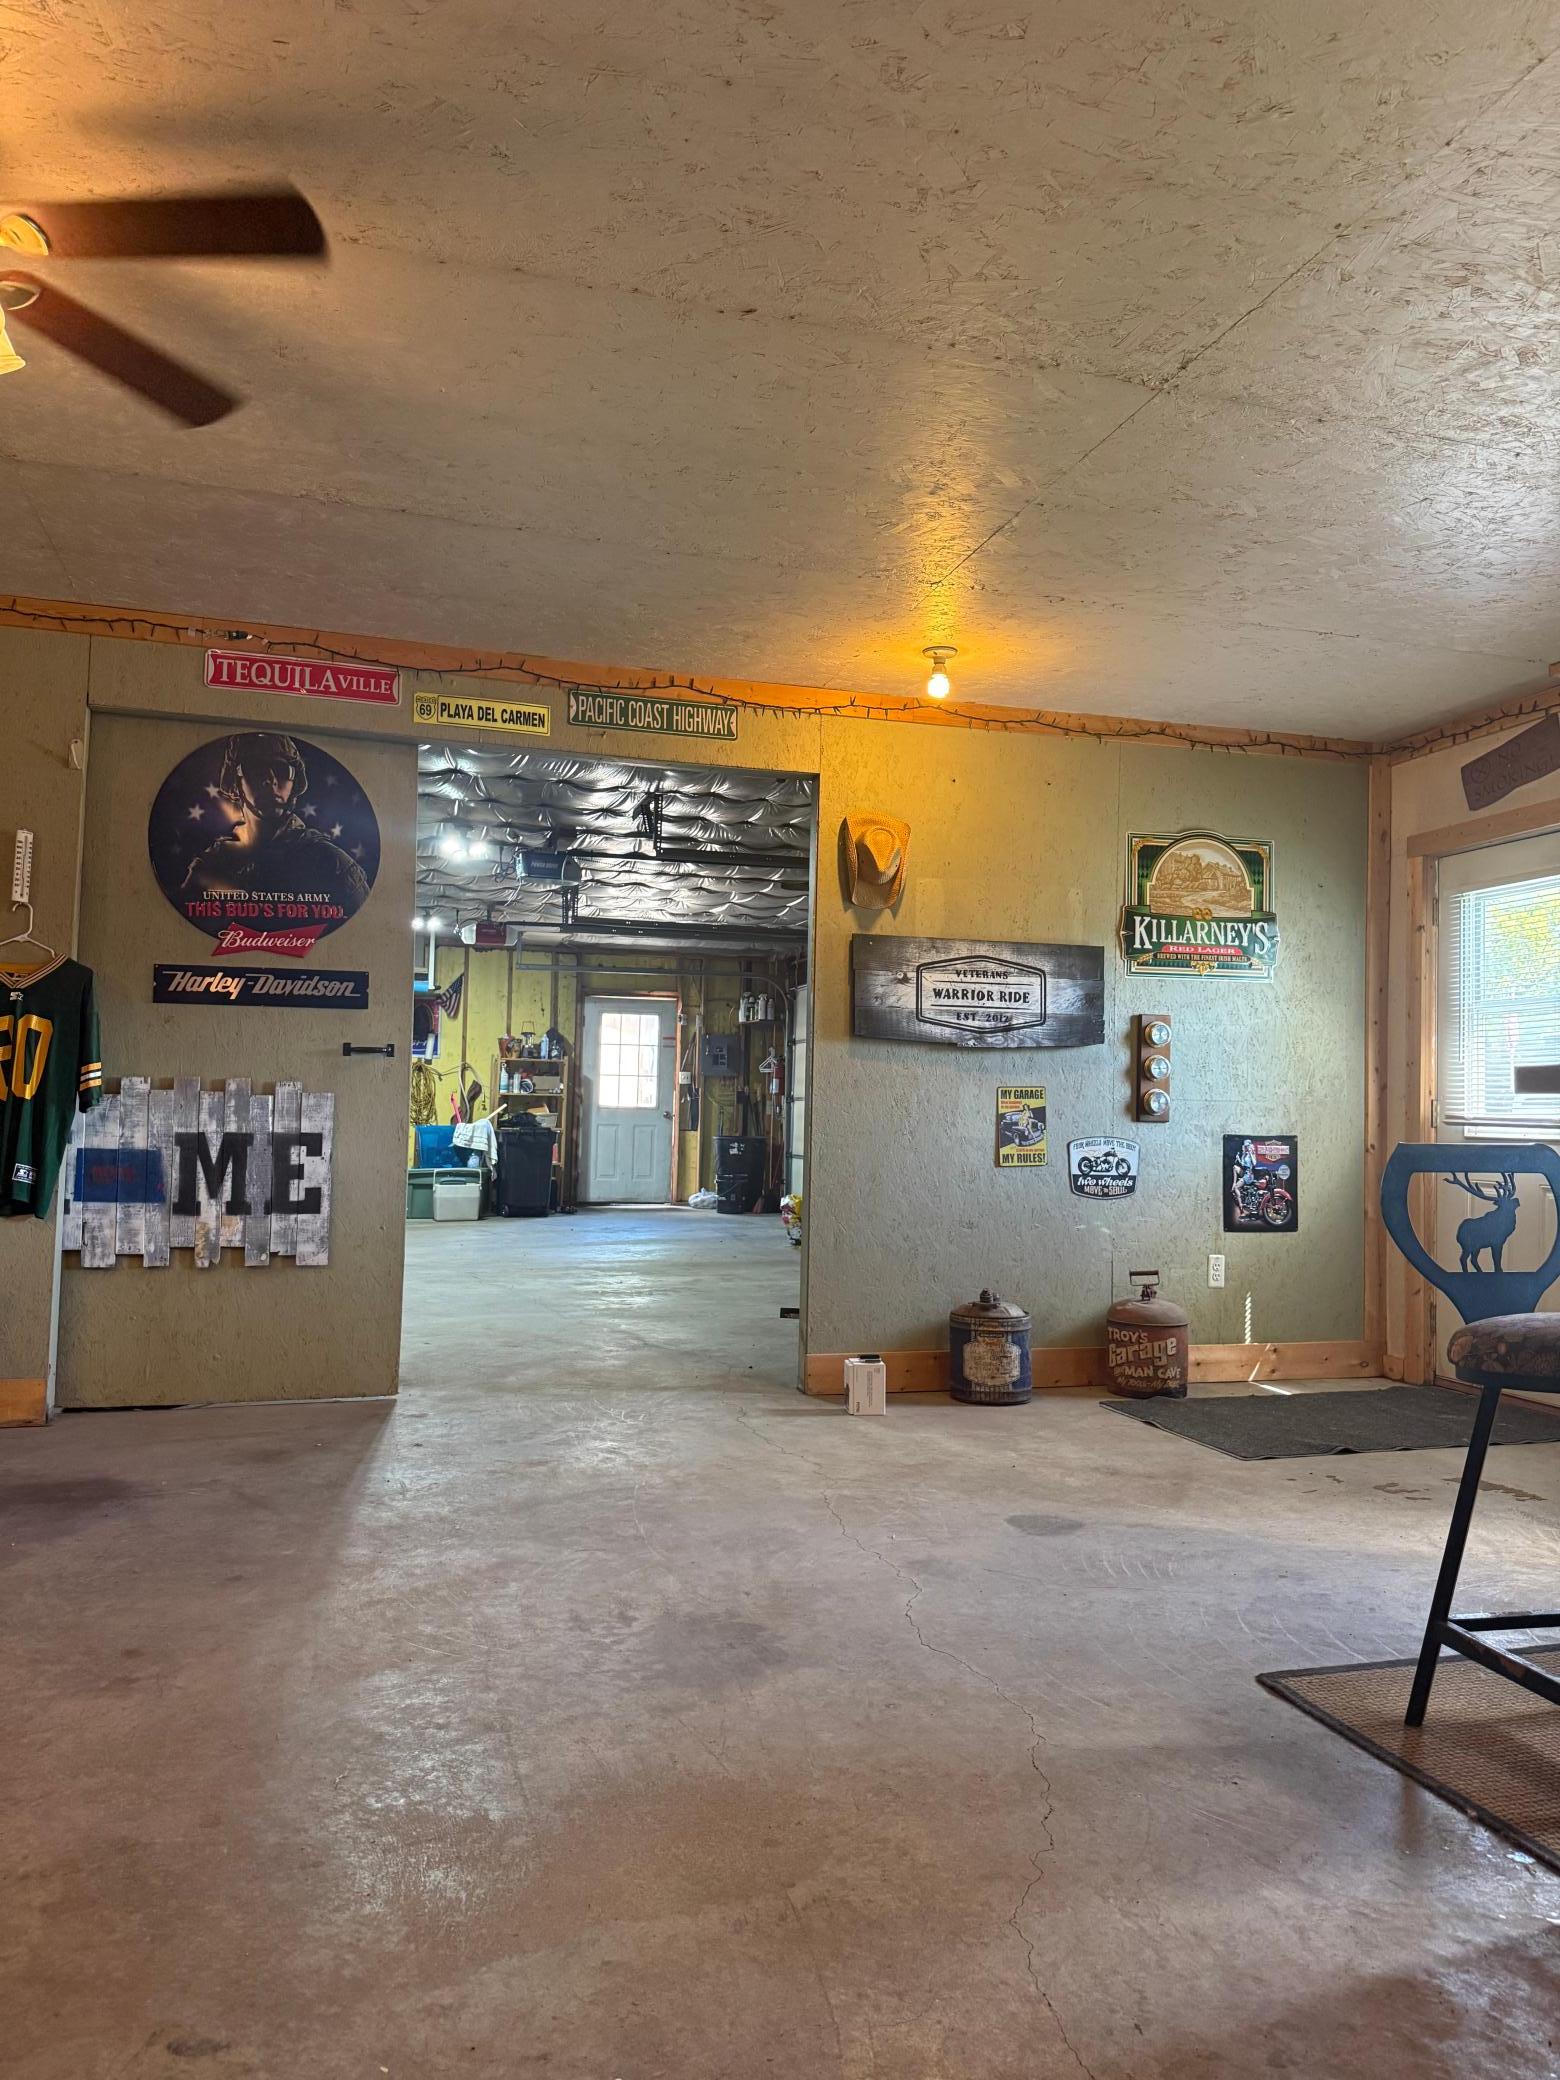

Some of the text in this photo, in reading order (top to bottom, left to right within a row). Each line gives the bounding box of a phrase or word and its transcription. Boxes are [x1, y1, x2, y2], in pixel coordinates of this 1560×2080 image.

[420, 703, 432, 716] 69
[440, 703, 545, 728] PLAYA DEL CARMEN
[578, 696, 731, 735] PACIFIC COAST HIGHWAY
[203, 891, 331, 903] UNITED STATES ARMY
[186, 902, 222, 917] THIS
[225, 903, 274, 918] BUD'S
[277, 903, 309, 918] FOR
[217, 930, 315, 948] Budweiser
[1133, 915, 1269, 954] KILLARNEY'S
[1198, 946, 1236, 954] LAGER
[955, 970, 1009, 979] VETERANS
[162, 971, 361, 1000] Harley-Davidson
[933, 988, 1030, 1004] WARRIOR RIDE
[956, 1012, 1009, 1023] EST. 2012
[1000, 1089, 1044, 1099] MY GARAGE
[1002, 1153, 1046, 1163] MY RULES!
[1084, 1186, 1102, 1195] MOVE
[1107, 1326, 1148, 1343] TROY'S
[1108, 1337, 1176, 1367] Garage
[1124, 1366, 1153, 1378] MAN
[1158, 1367, 1181, 1379] CAVE
